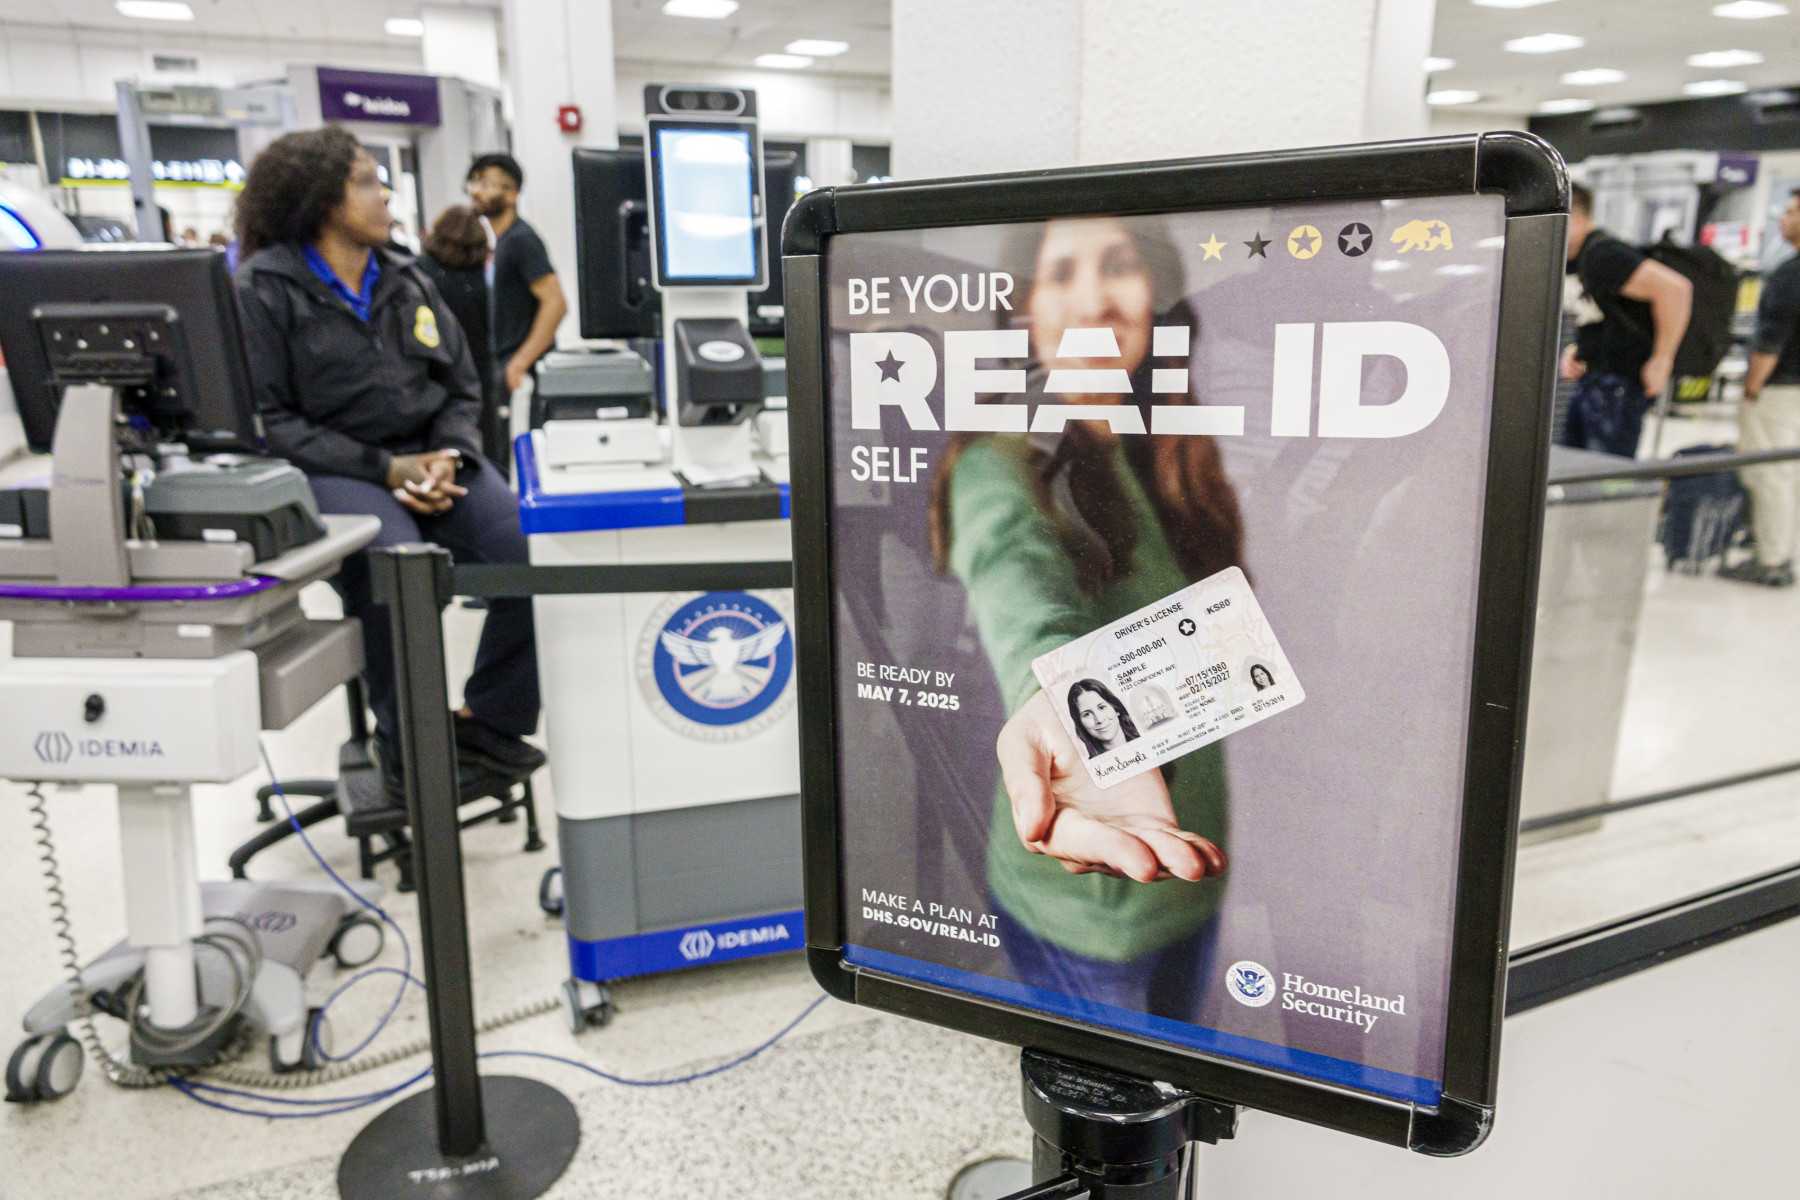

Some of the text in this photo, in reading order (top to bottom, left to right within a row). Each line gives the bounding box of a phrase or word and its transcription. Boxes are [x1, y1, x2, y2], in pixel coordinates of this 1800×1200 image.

[847, 271, 1015, 316] BE YOUR
[849, 320, 1452, 439] REAL ID
[850, 445, 929, 484] SELF
[1114, 601, 1185, 640] DRIVER'S LICENSE
[1119, 637, 1168, 665] S00-000-001
[857, 662, 955, 688] BE READY BY
[1116, 662, 1148, 681] SAMPLE
[1119, 676, 1133, 687] KIM
[1186, 661, 1227, 687] 07/15/1980
[1190, 670, 1231, 695] 02/15/2027
[857, 682, 960, 711] MAY 7, 2025
[79, 740, 165, 757] IDEMIA
[862, 887, 998, 930] MAKE A PLAN AT
[716, 923, 790, 950] IDEMIA
[862, 906, 1001, 948] DHS.GOV/REAL-ID
[1282, 972, 1406, 1016] Homeland
[1282, 992, 1378, 1034] Security
